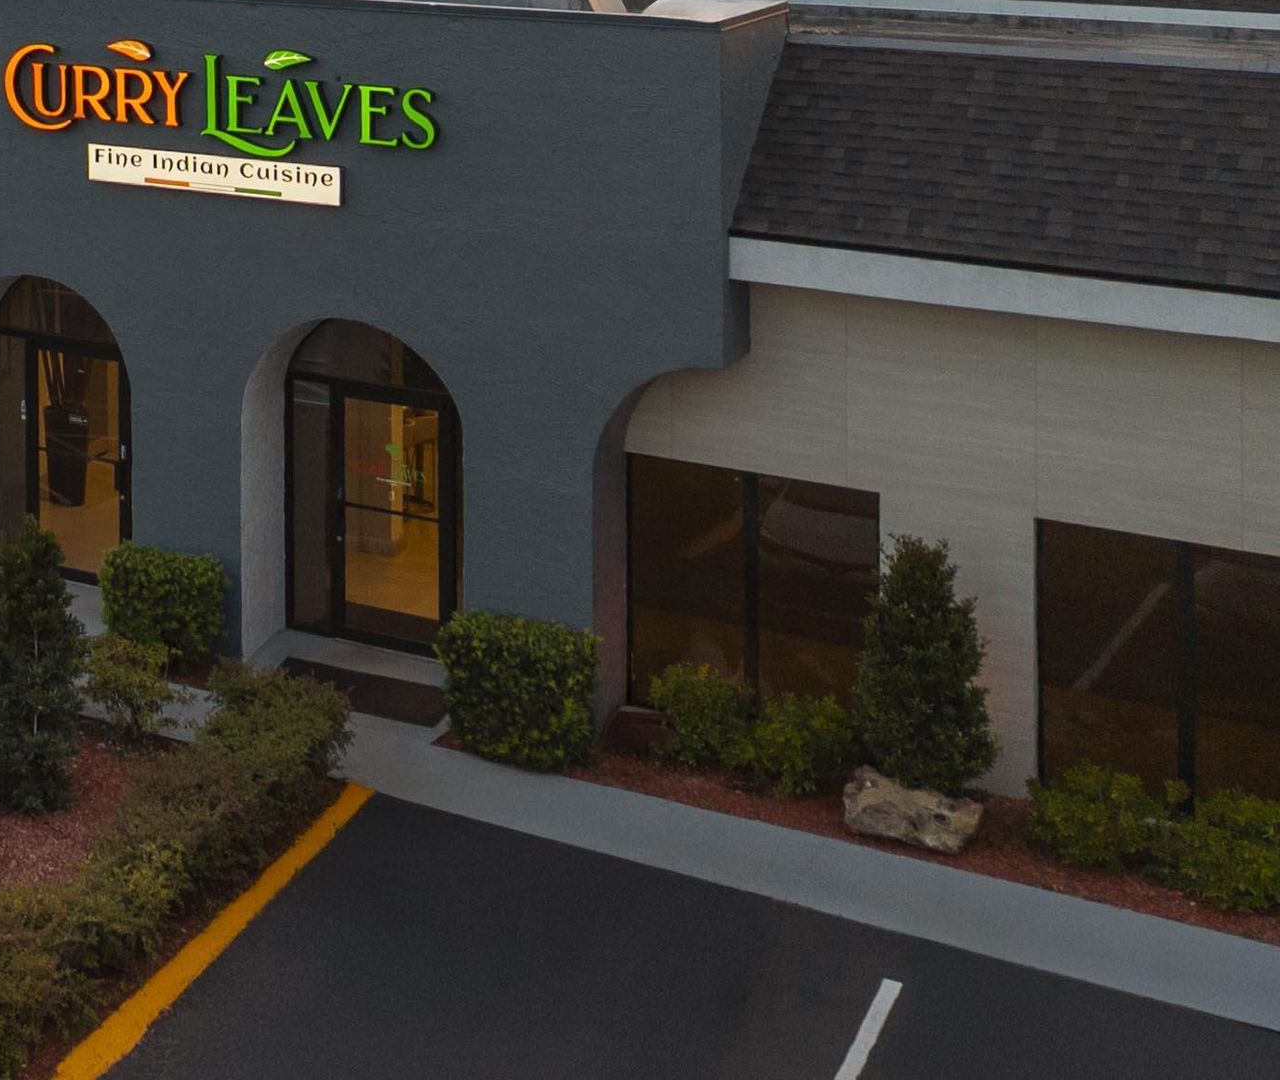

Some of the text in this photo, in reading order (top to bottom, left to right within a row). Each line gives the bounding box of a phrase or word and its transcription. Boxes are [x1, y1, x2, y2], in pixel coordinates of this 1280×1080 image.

[4, 44, 436, 157] CURRY LEAVES
[94, 148, 335, 188] Fine Indian Cuisine
